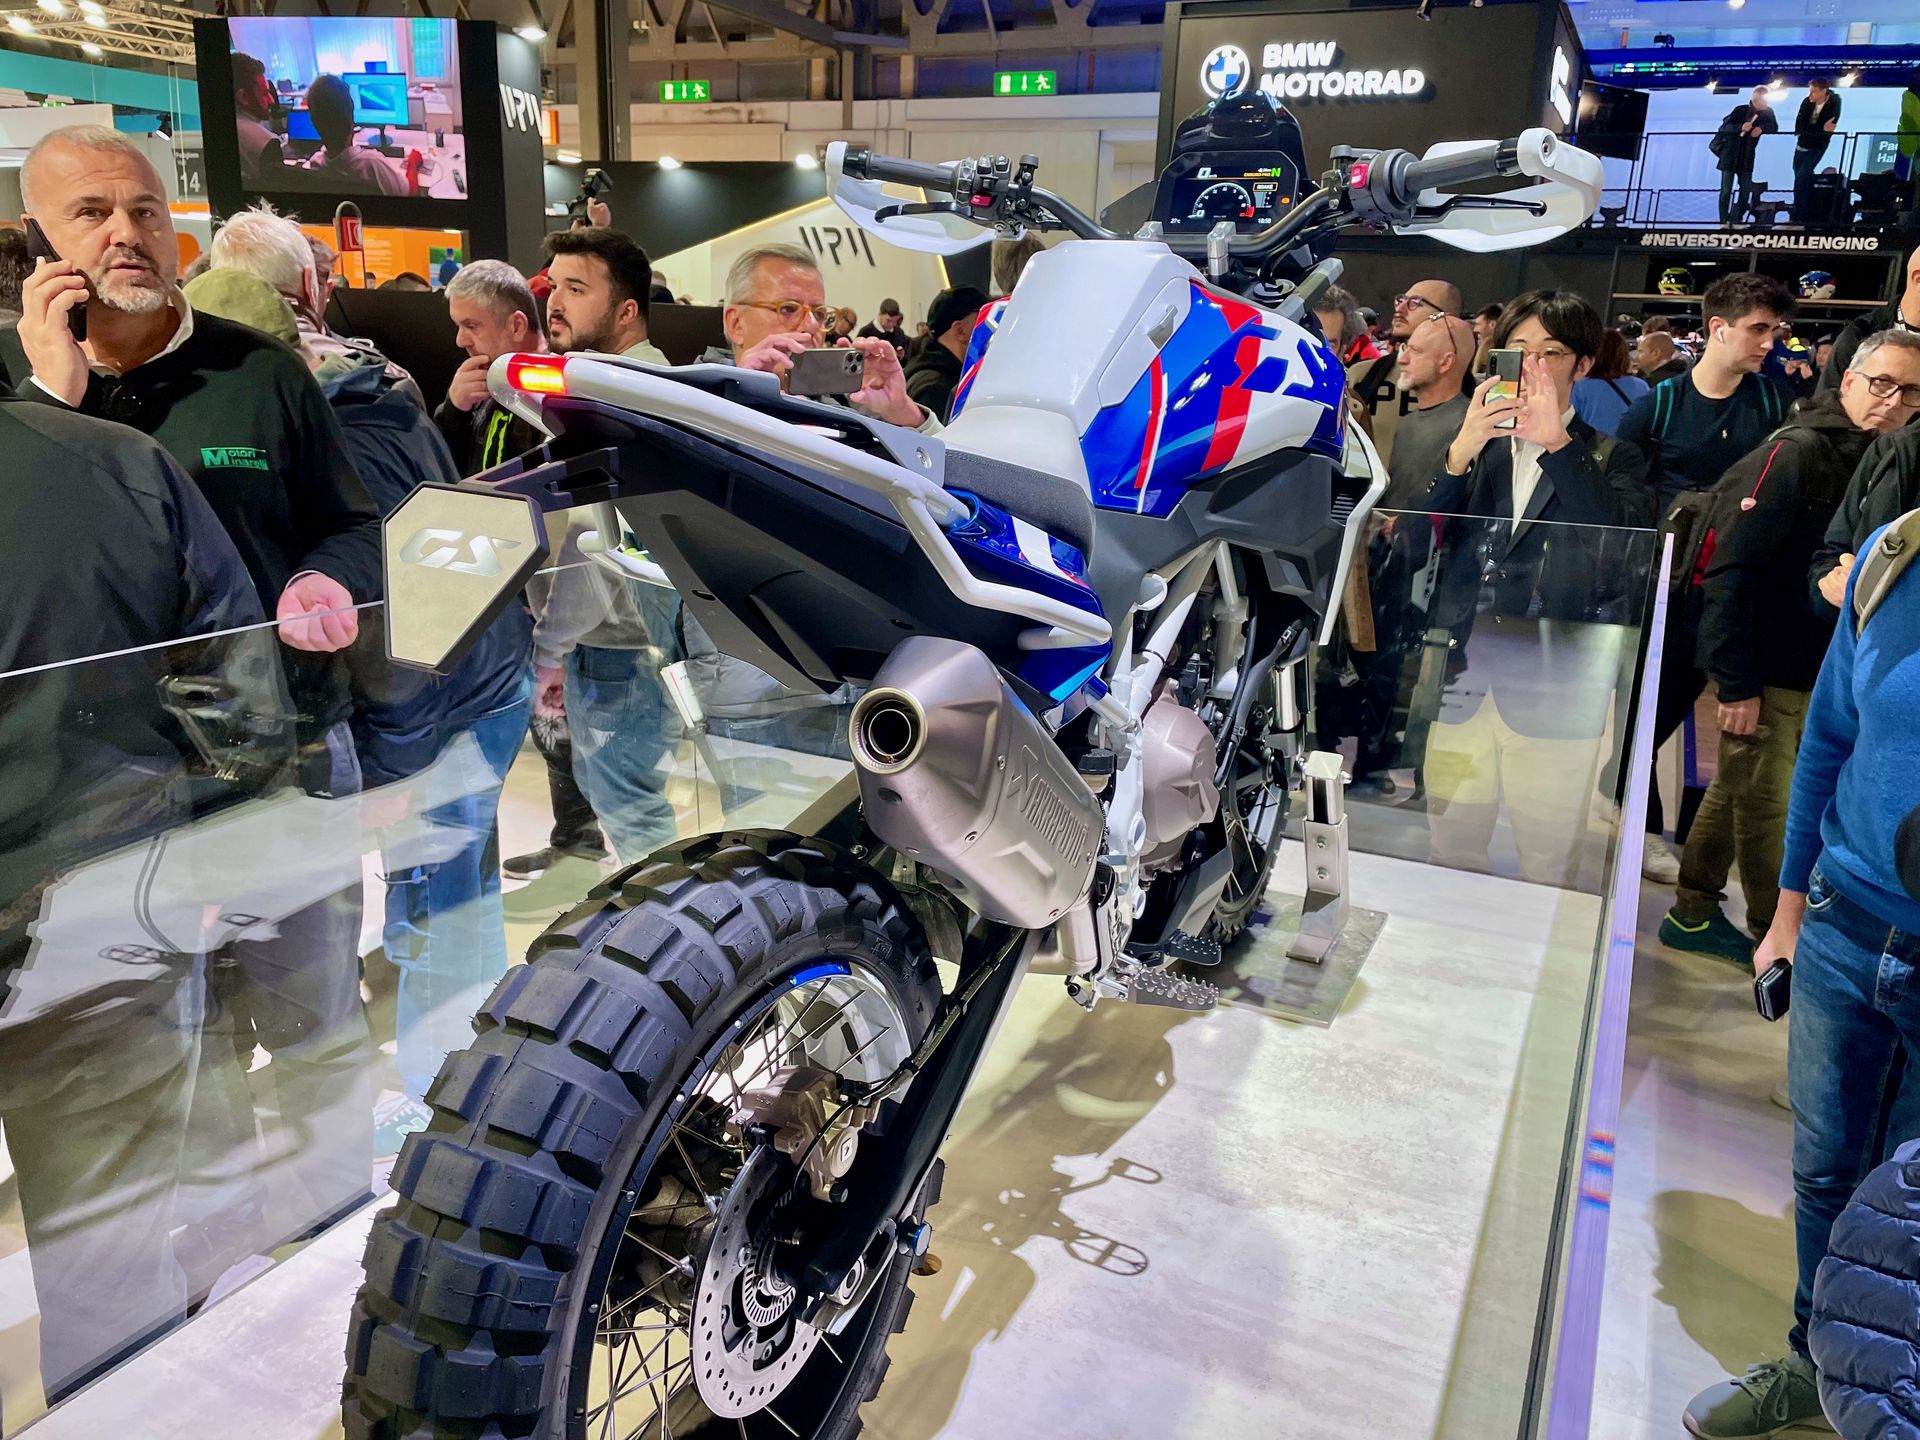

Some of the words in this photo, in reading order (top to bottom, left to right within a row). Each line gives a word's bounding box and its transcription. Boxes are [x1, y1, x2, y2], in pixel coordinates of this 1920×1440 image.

[1262, 41, 1337, 68] BMW
[1259, 69, 1425, 98] MOTORRAD
[1271, 167, 1281, 177] N
[1640, 233, 1879, 251] #NEVERSTOPCHALLENGING
[398, 527, 522, 578] GS
